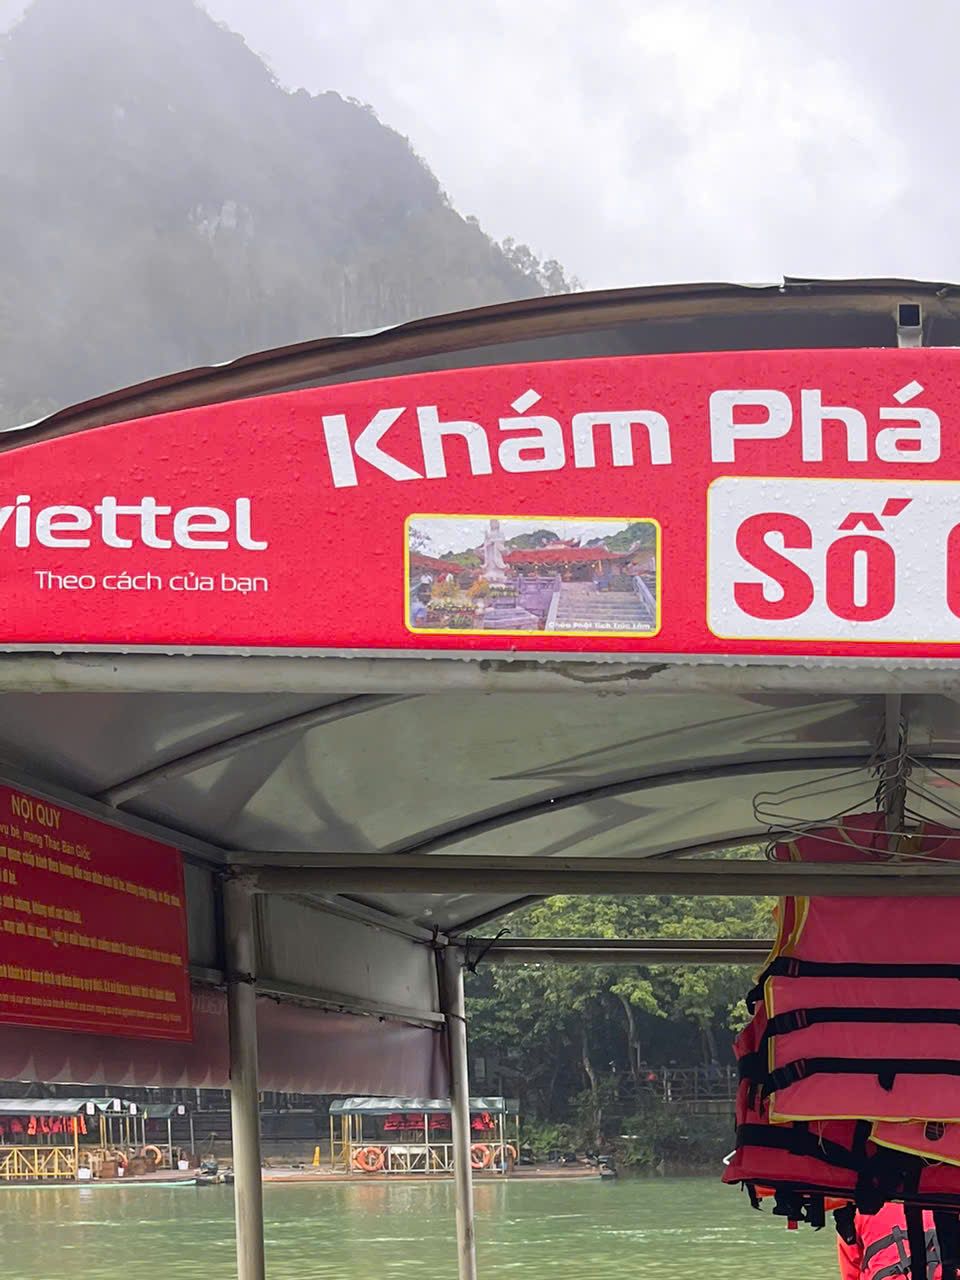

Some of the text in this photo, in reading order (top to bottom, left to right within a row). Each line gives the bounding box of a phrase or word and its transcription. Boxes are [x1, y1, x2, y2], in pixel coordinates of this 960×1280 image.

[321, 388, 672, 488] Khám
[709, 380, 941, 464] Phá
[35, 571, 268, 595] Theo cách của bạn
[733, 498, 914, 622] Số
[36, 804, 60, 829] QUY
